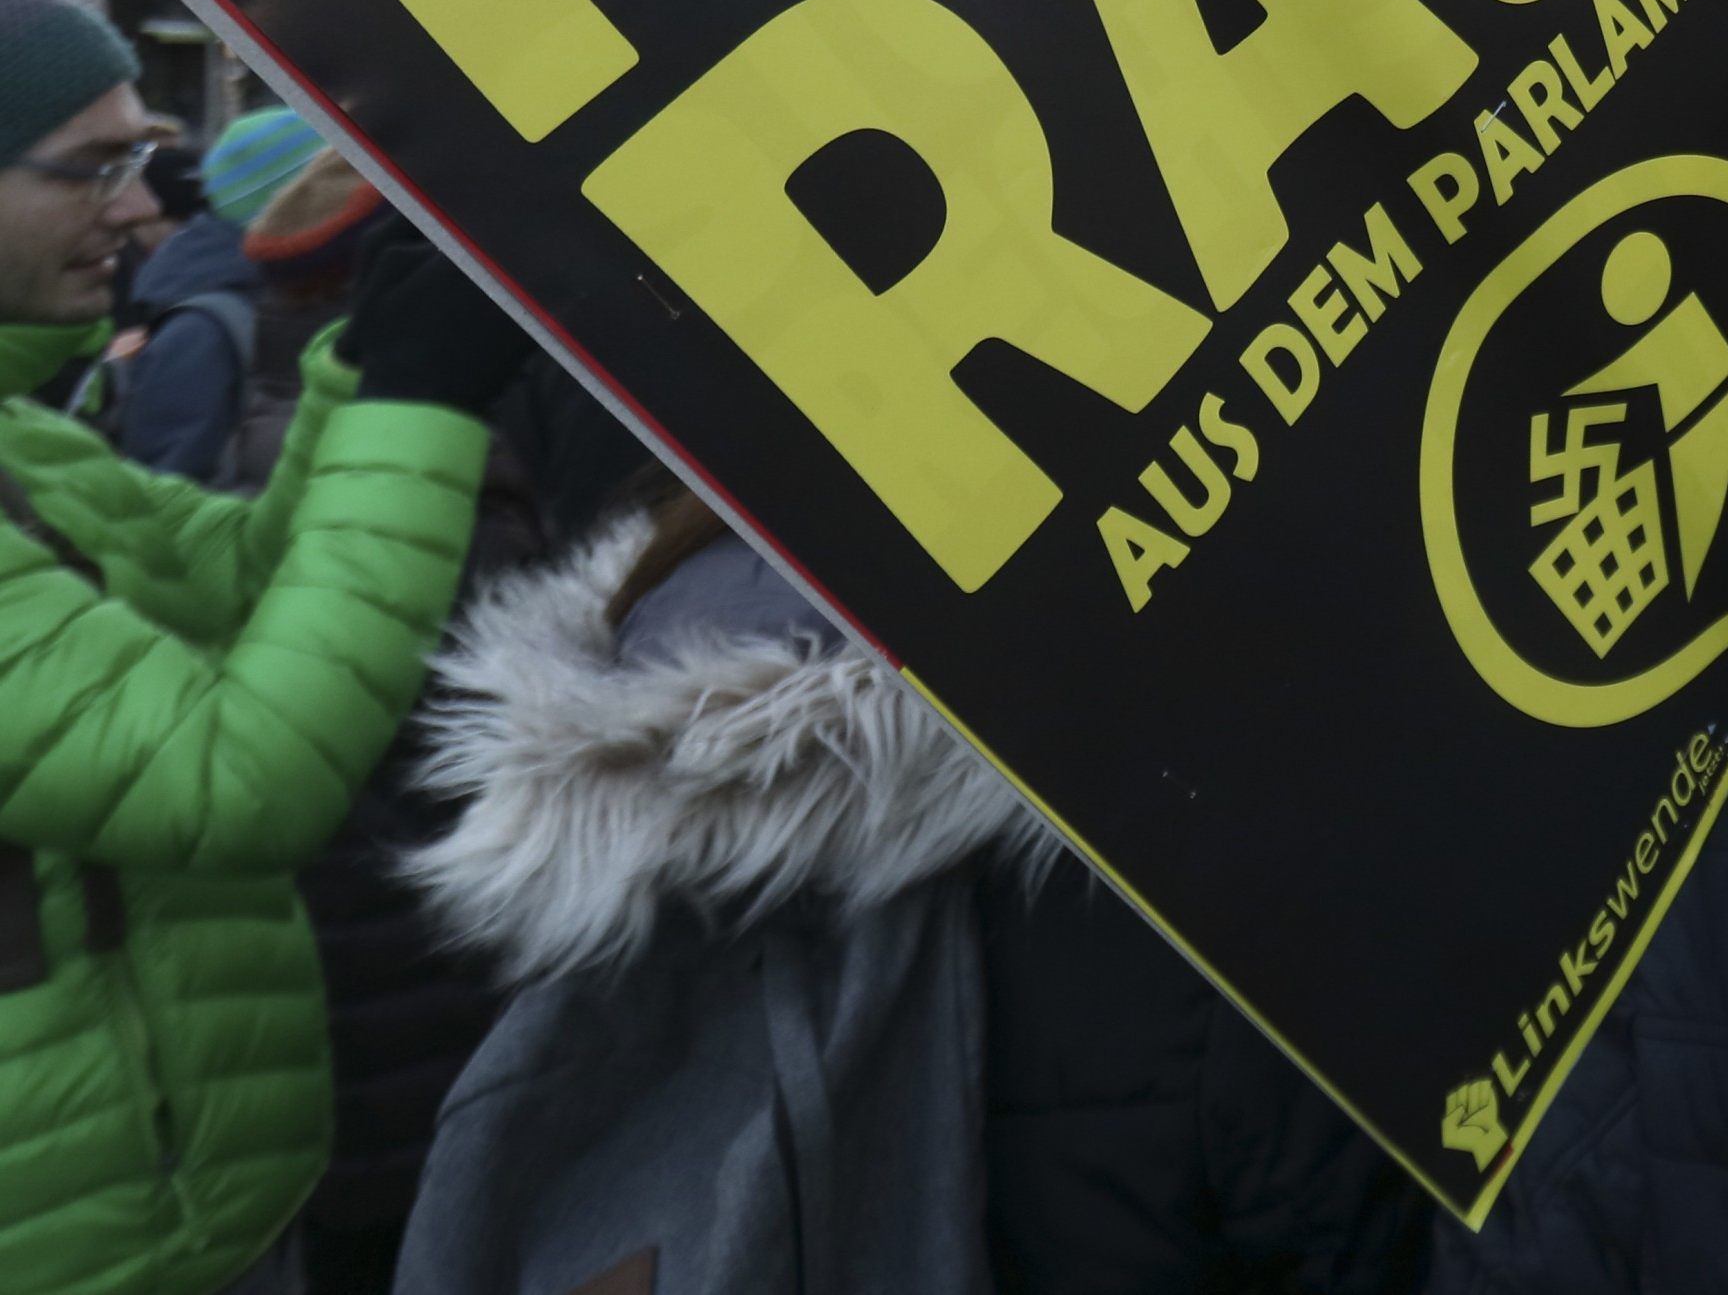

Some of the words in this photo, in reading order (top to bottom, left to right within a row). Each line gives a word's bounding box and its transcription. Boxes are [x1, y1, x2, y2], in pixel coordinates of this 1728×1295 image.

[1096, 391, 1260, 614] AUS
[1239, 201, 1424, 427] DEM
[1489, 731, 1710, 1097] Linkswende
